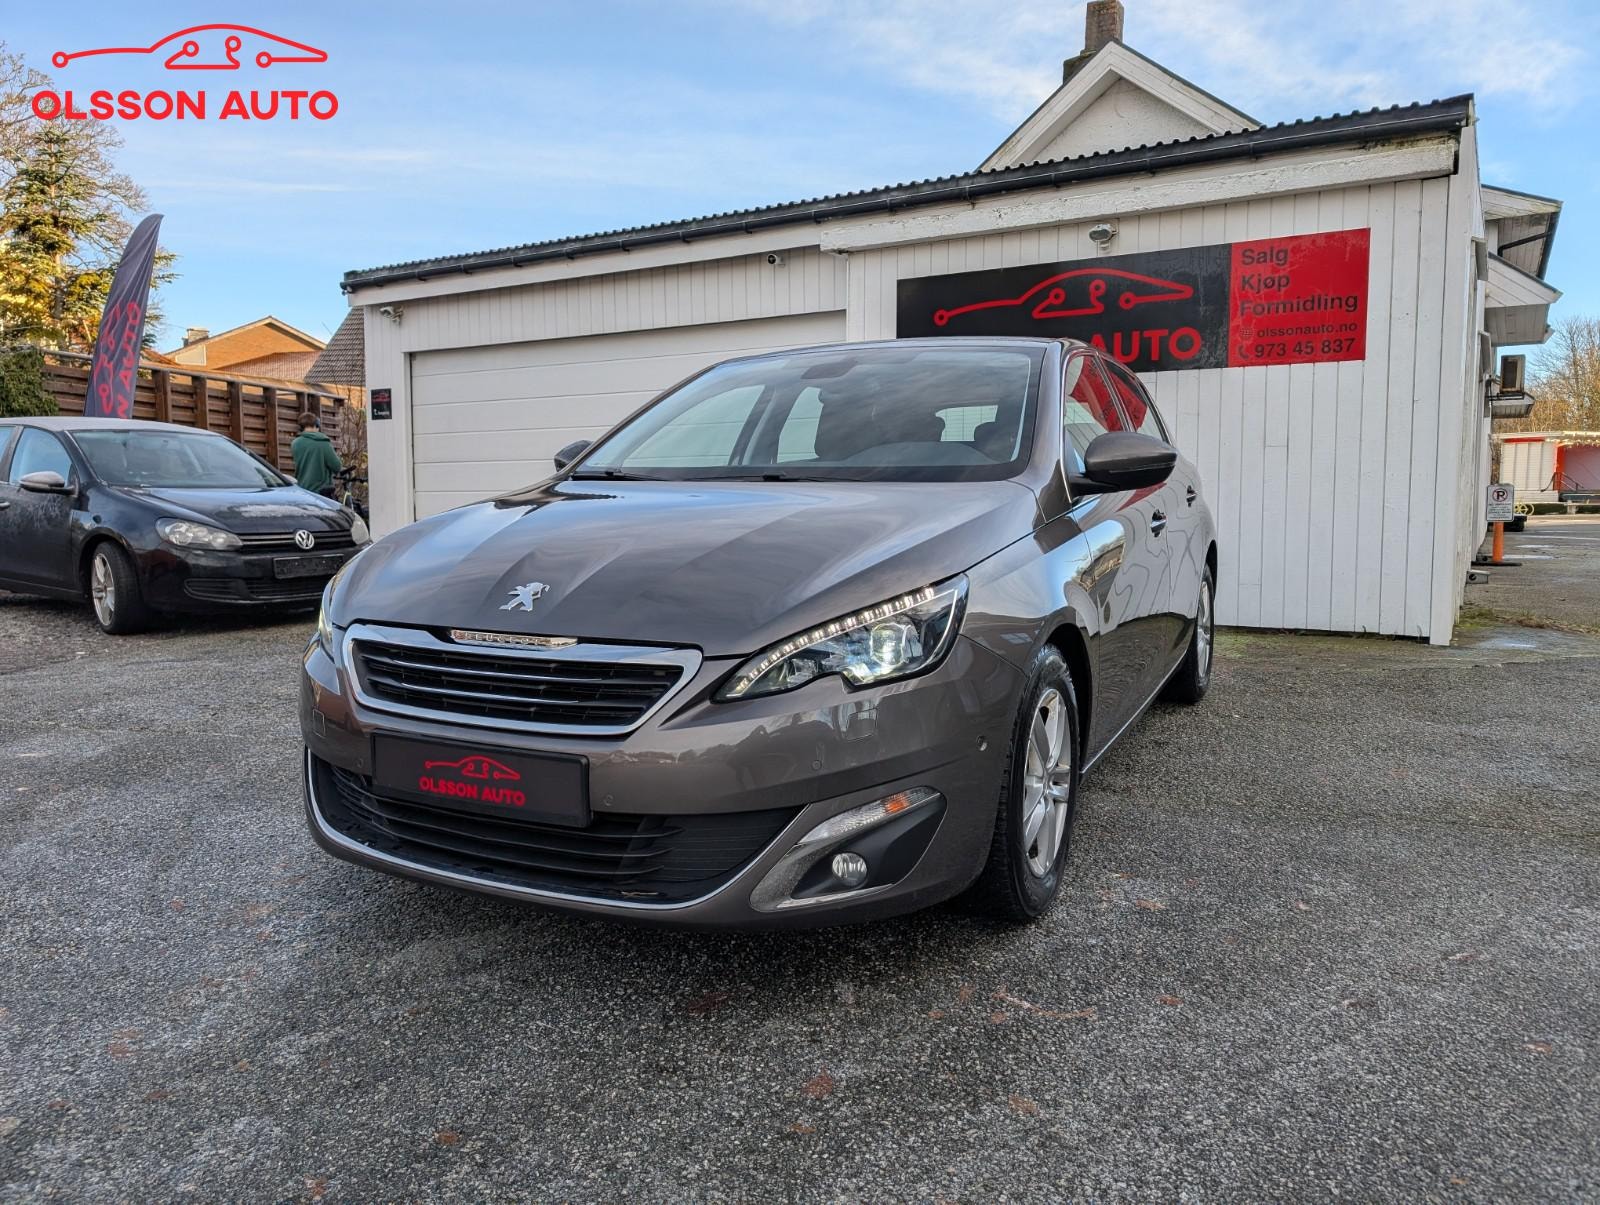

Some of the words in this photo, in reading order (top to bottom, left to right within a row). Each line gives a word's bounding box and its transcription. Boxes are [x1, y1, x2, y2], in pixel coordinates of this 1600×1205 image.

[1241, 246, 1289, 266] Salg
[1241, 273, 1290, 293] Kjøp
[1240, 294, 1359, 316] Formidling
[1257, 322, 1358, 338] olssonauto.no
[1254, 342, 1287, 358] 973
[1293, 341, 1315, 356] 45
[1321, 338, 1356, 354] 837
[419, 776, 478, 799] OLSSON
[481, 785, 526, 807] AUTO
